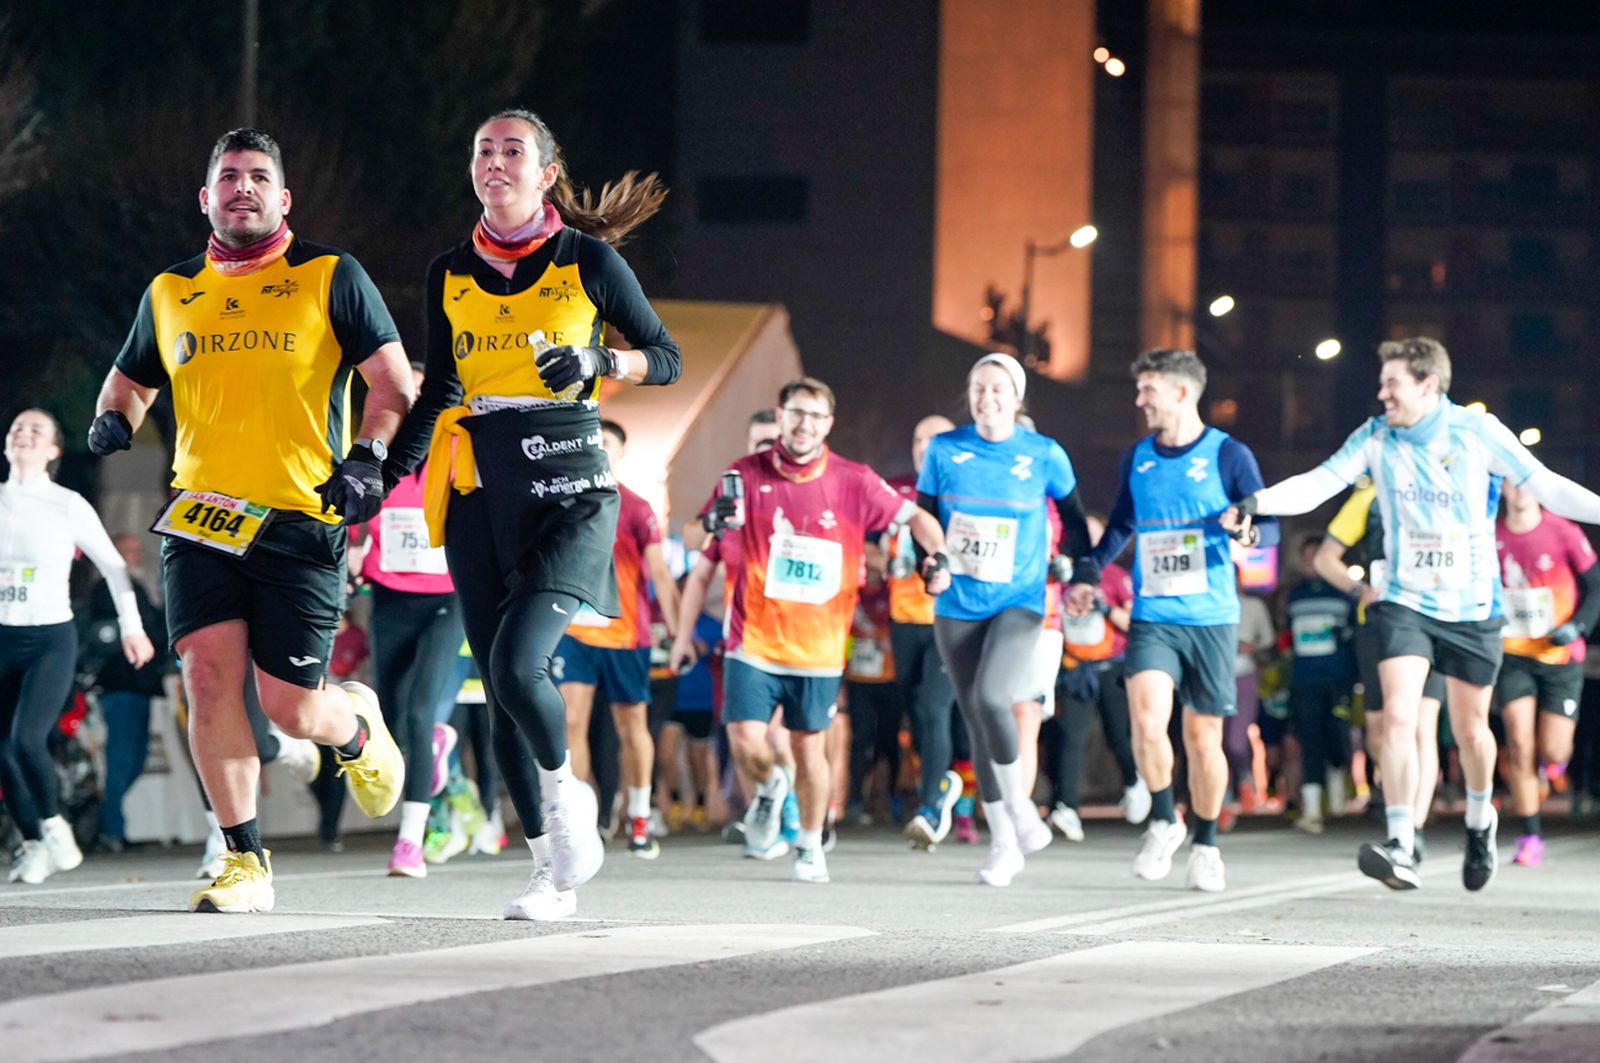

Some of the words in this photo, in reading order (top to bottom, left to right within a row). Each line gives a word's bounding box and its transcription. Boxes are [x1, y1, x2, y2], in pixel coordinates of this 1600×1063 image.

[174, 330, 297, 365] AIRZONE
[455, 330, 564, 360] AIRZOE
[529, 438, 583, 455] SALDENT
[183, 502, 246, 537] 4164
[961, 537, 998, 558] 2477
[786, 558, 822, 580] 7812
[1153, 554, 1191, 574] 2479
[1415, 550, 1454, 568] 2478
